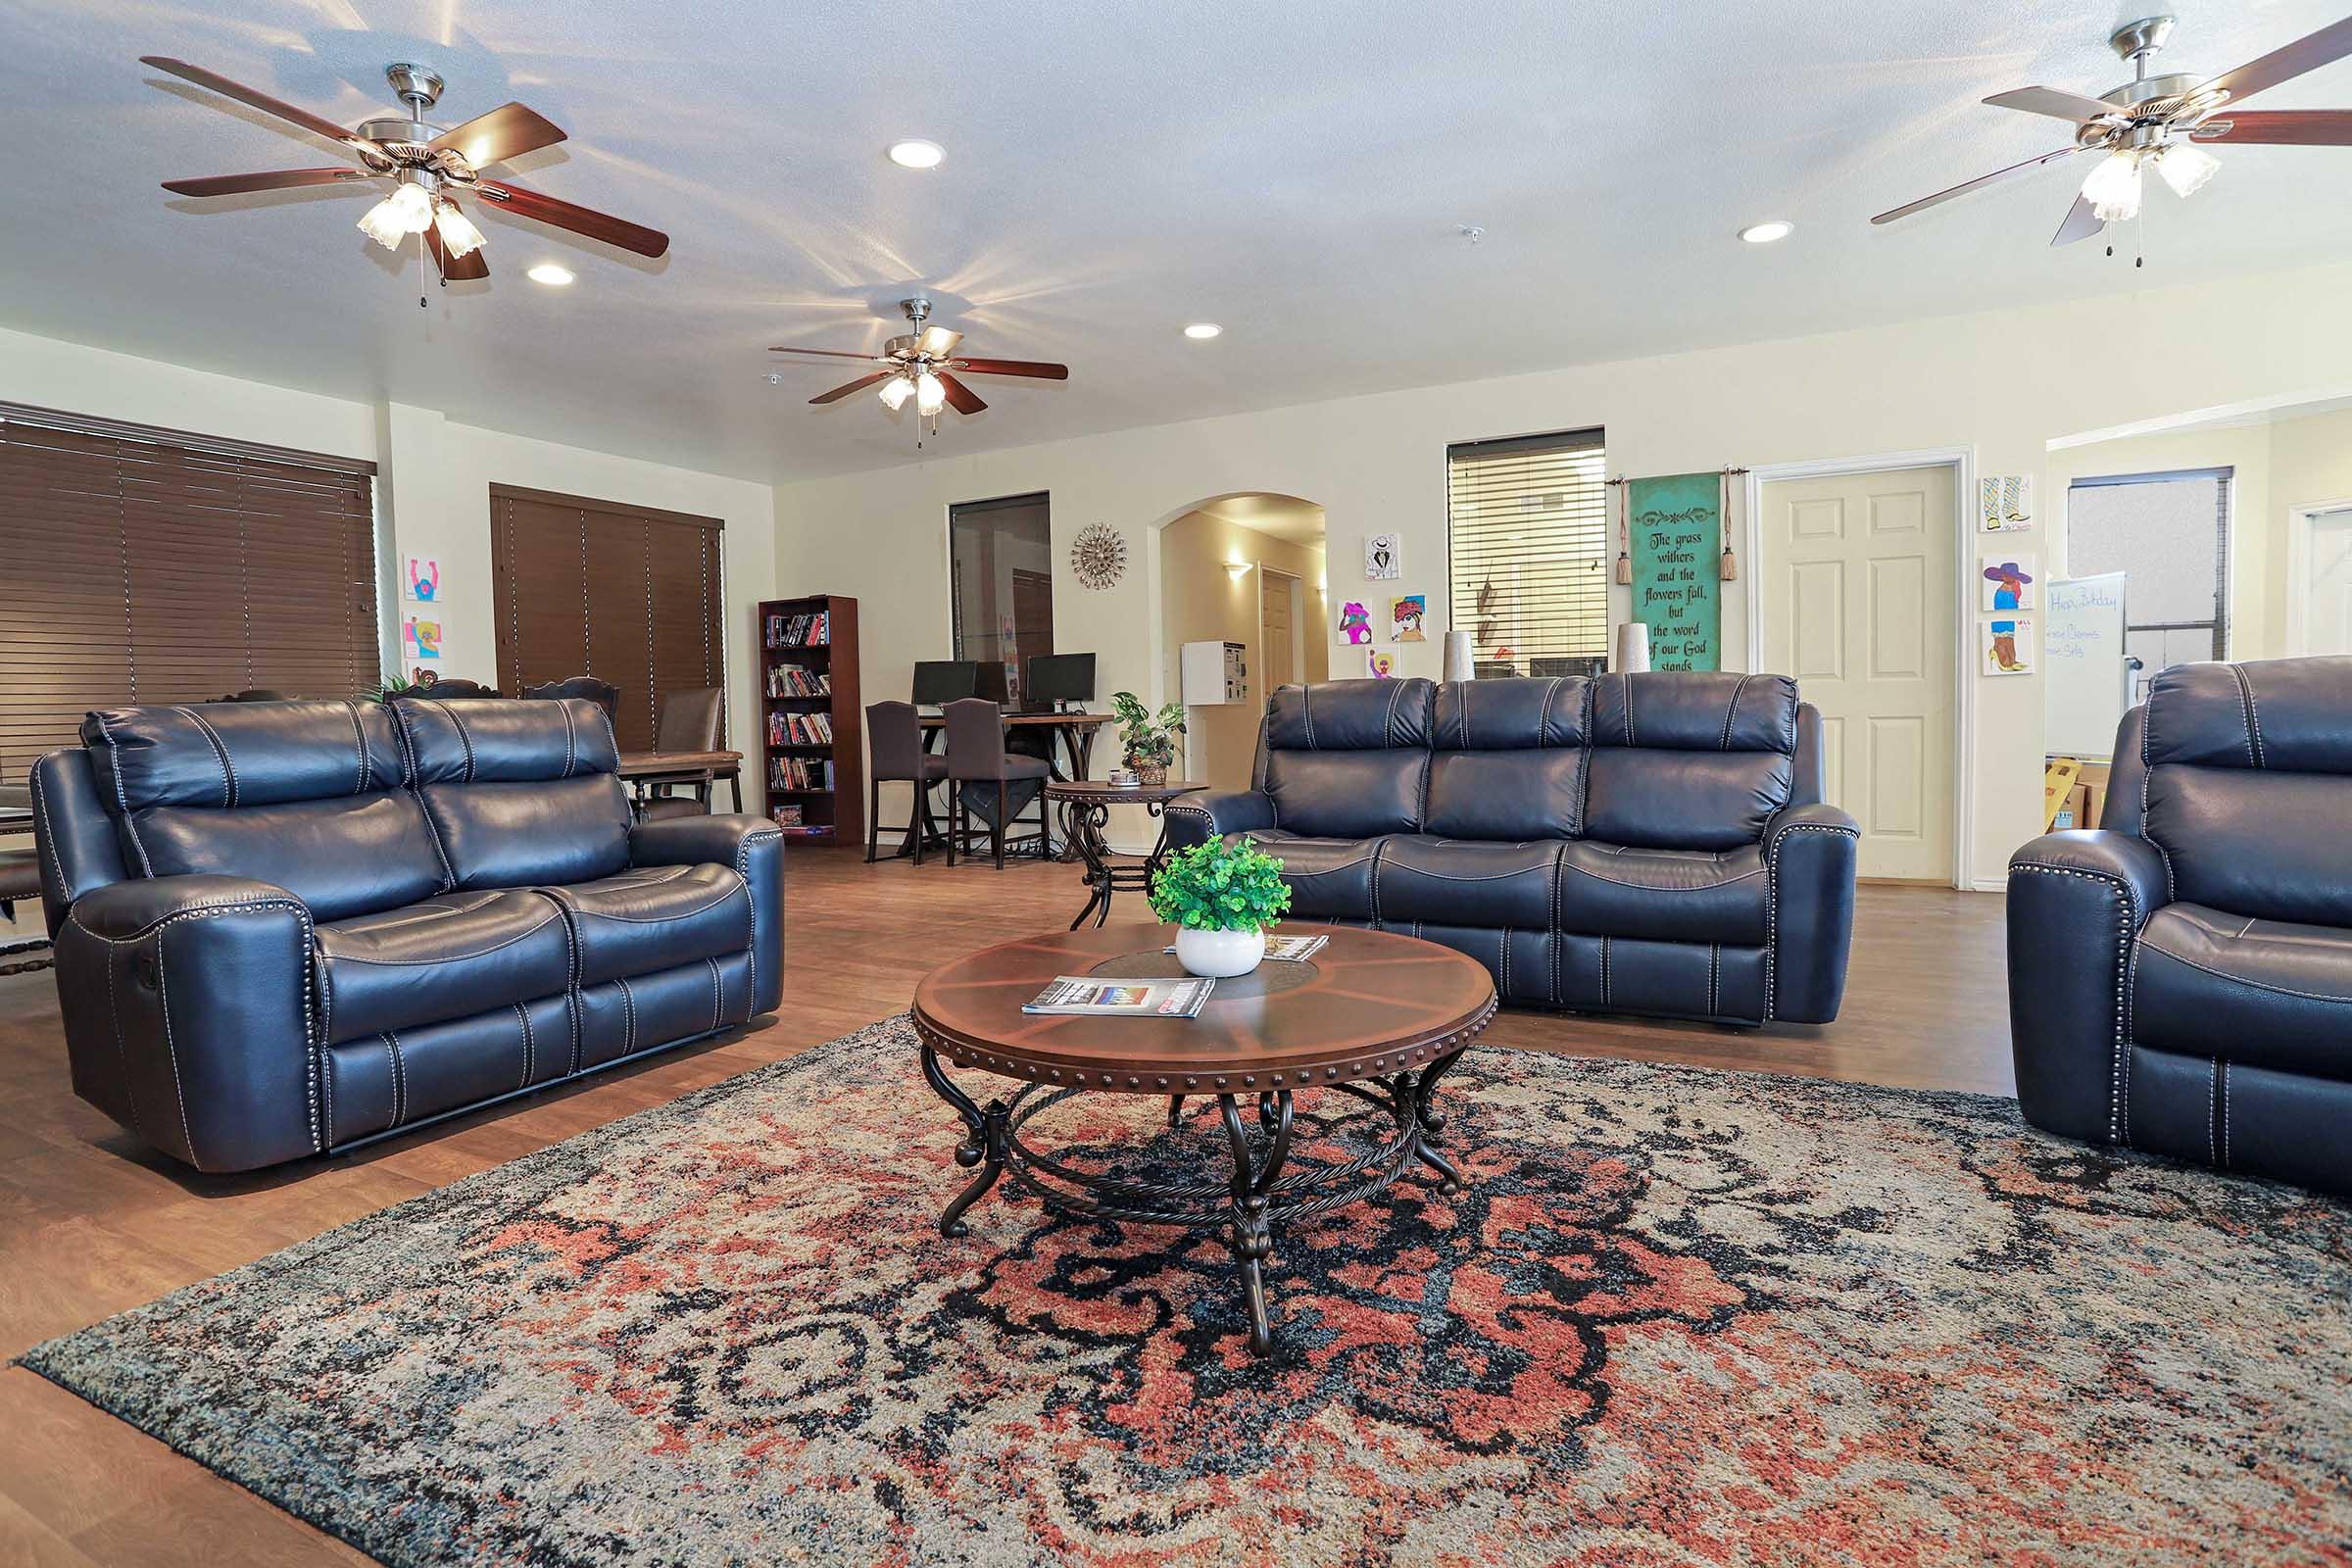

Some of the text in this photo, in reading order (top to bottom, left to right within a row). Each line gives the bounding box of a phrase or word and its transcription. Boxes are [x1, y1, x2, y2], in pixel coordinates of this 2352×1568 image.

[1649, 533, 1702, 550] The grass
[1657, 551, 1695, 564] withers
[1657, 567, 1694, 582] and the
[1644, 587, 1683, 607] flowers
[1669, 606, 1684, 618] but
[1653, 621, 1699, 637] the word
[1661, 645, 1679, 655] our
[1684, 640, 1706, 658] God
[1661, 659, 1692, 672] stands
